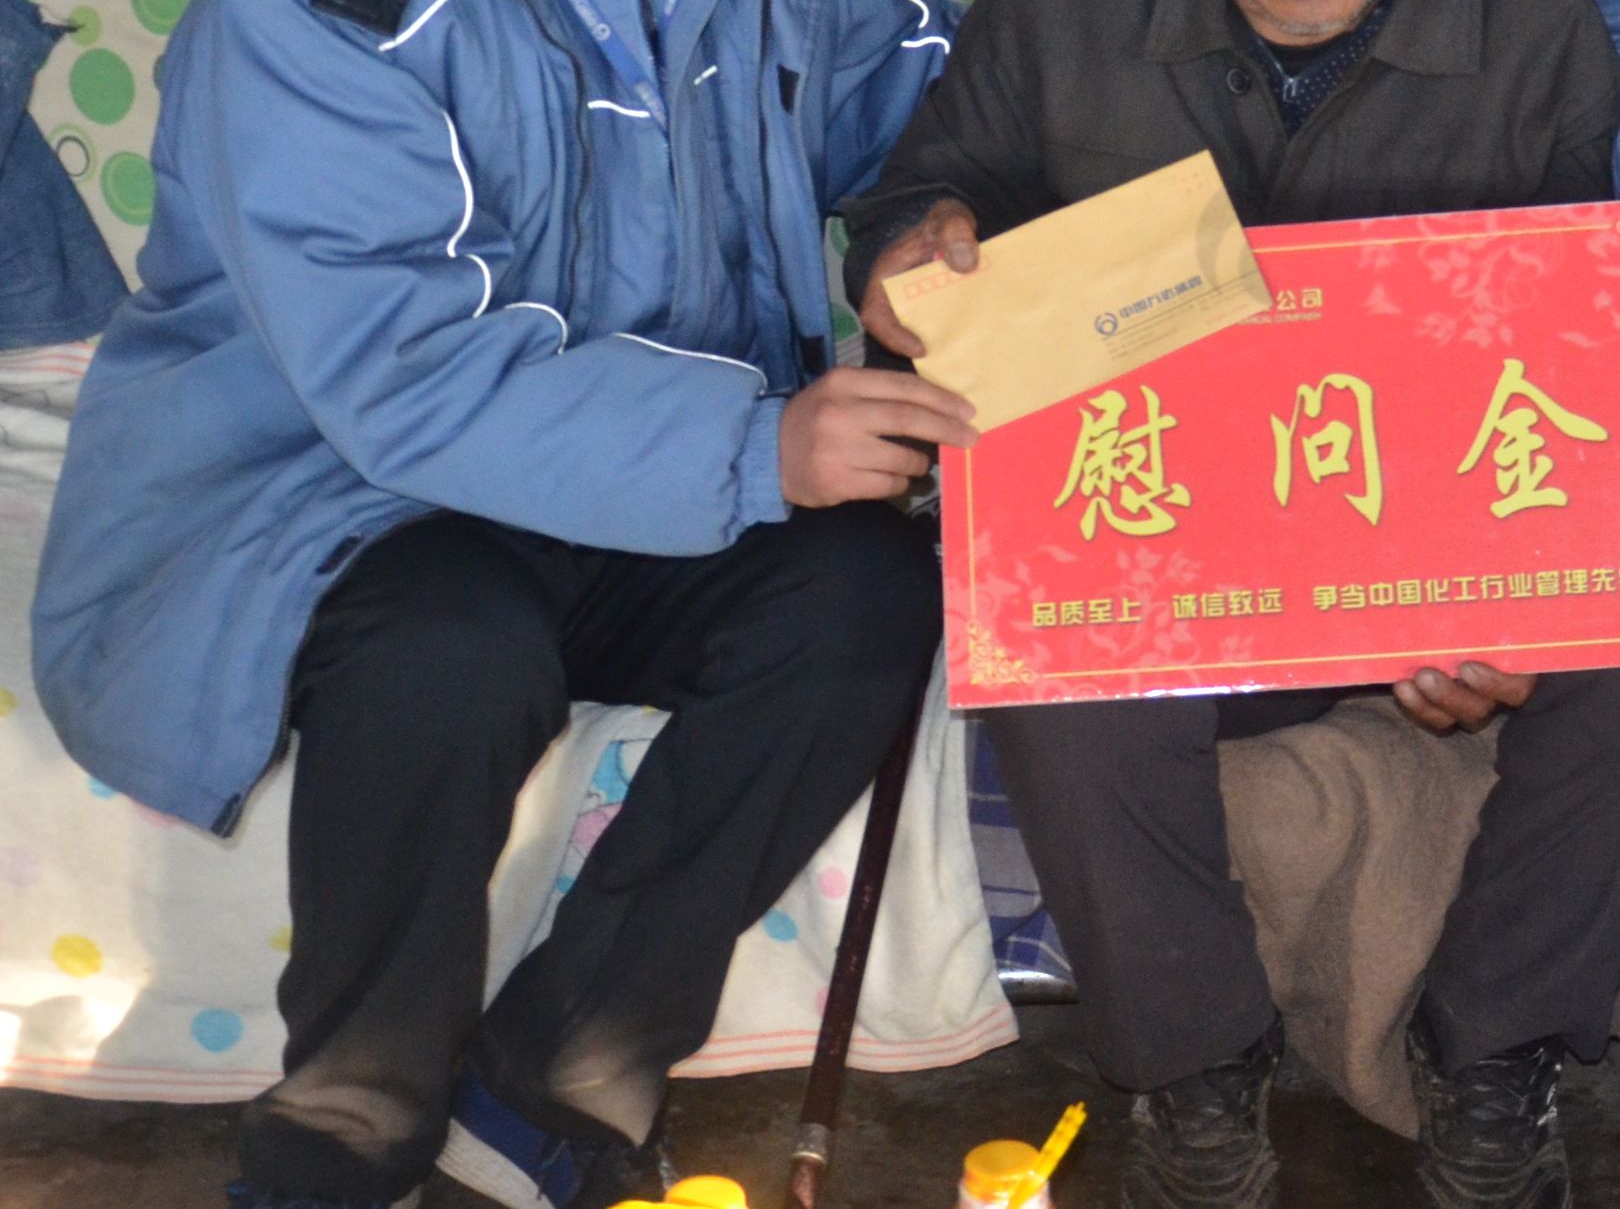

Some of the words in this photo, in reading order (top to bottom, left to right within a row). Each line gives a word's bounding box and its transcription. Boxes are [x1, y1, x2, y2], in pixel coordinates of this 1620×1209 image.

[1276, 288, 1323, 311] 公司
[1053, 358, 1608, 541] 慰问金
[1031, 595, 1143, 627] 品质至上
[1171, 587, 1284, 619] 诚信致远
